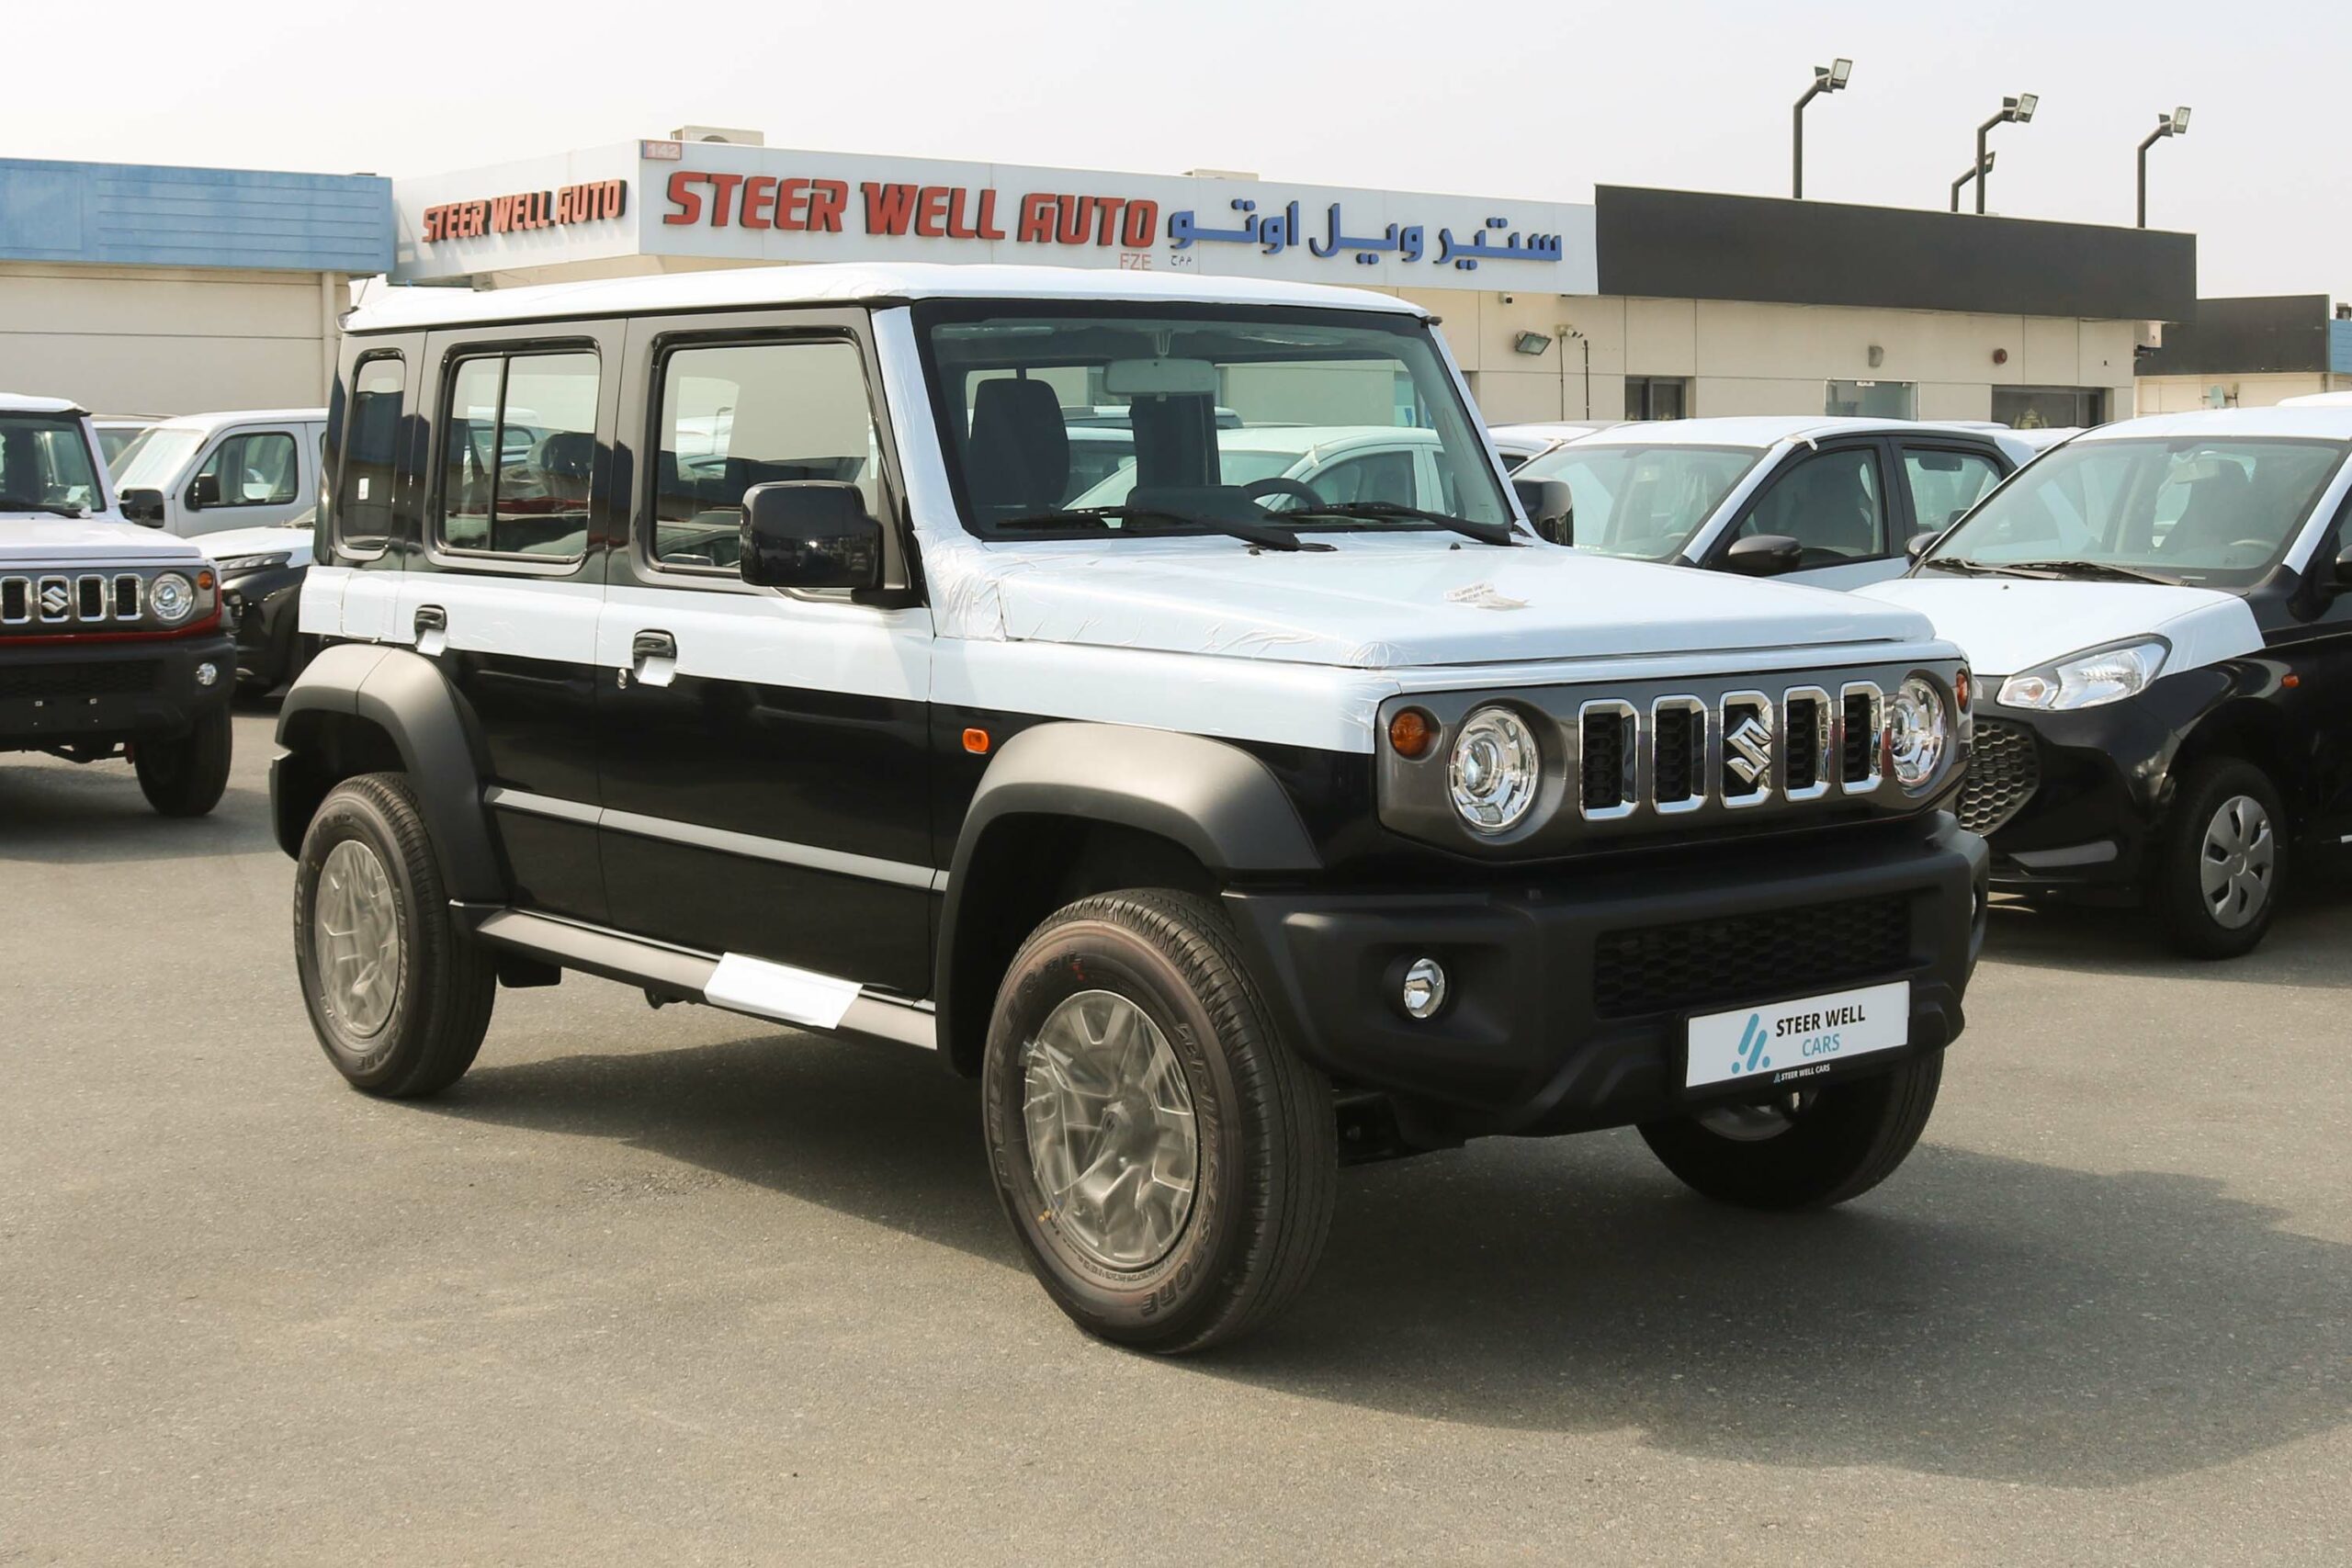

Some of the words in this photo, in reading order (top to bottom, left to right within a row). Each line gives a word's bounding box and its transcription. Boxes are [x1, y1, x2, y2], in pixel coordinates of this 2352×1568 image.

[648, 143, 678, 157] 142
[423, 199, 491, 243] STEER
[492, 191, 552, 233] WELL
[554, 179, 628, 225] AUTO
[663, 171, 849, 232] STEER
[861, 182, 1005, 240] WELL
[1017, 193, 1159, 248] AUTO
[1168, 198, 1299, 254] اوتو
[1308, 203, 1423, 265] ويل
[1433, 217, 1562, 270] ستير
[1120, 253, 1152, 270] FZE
[1776, 1012, 1821, 1037] STEER
[1825, 1004, 1866, 1028] WELL
[1803, 1033, 1839, 1056] CARS
[1781, 1070, 1798, 1081] STEER
[1799, 1066, 1815, 1077] WELL
[1815, 1063, 1830, 1074] CARS
